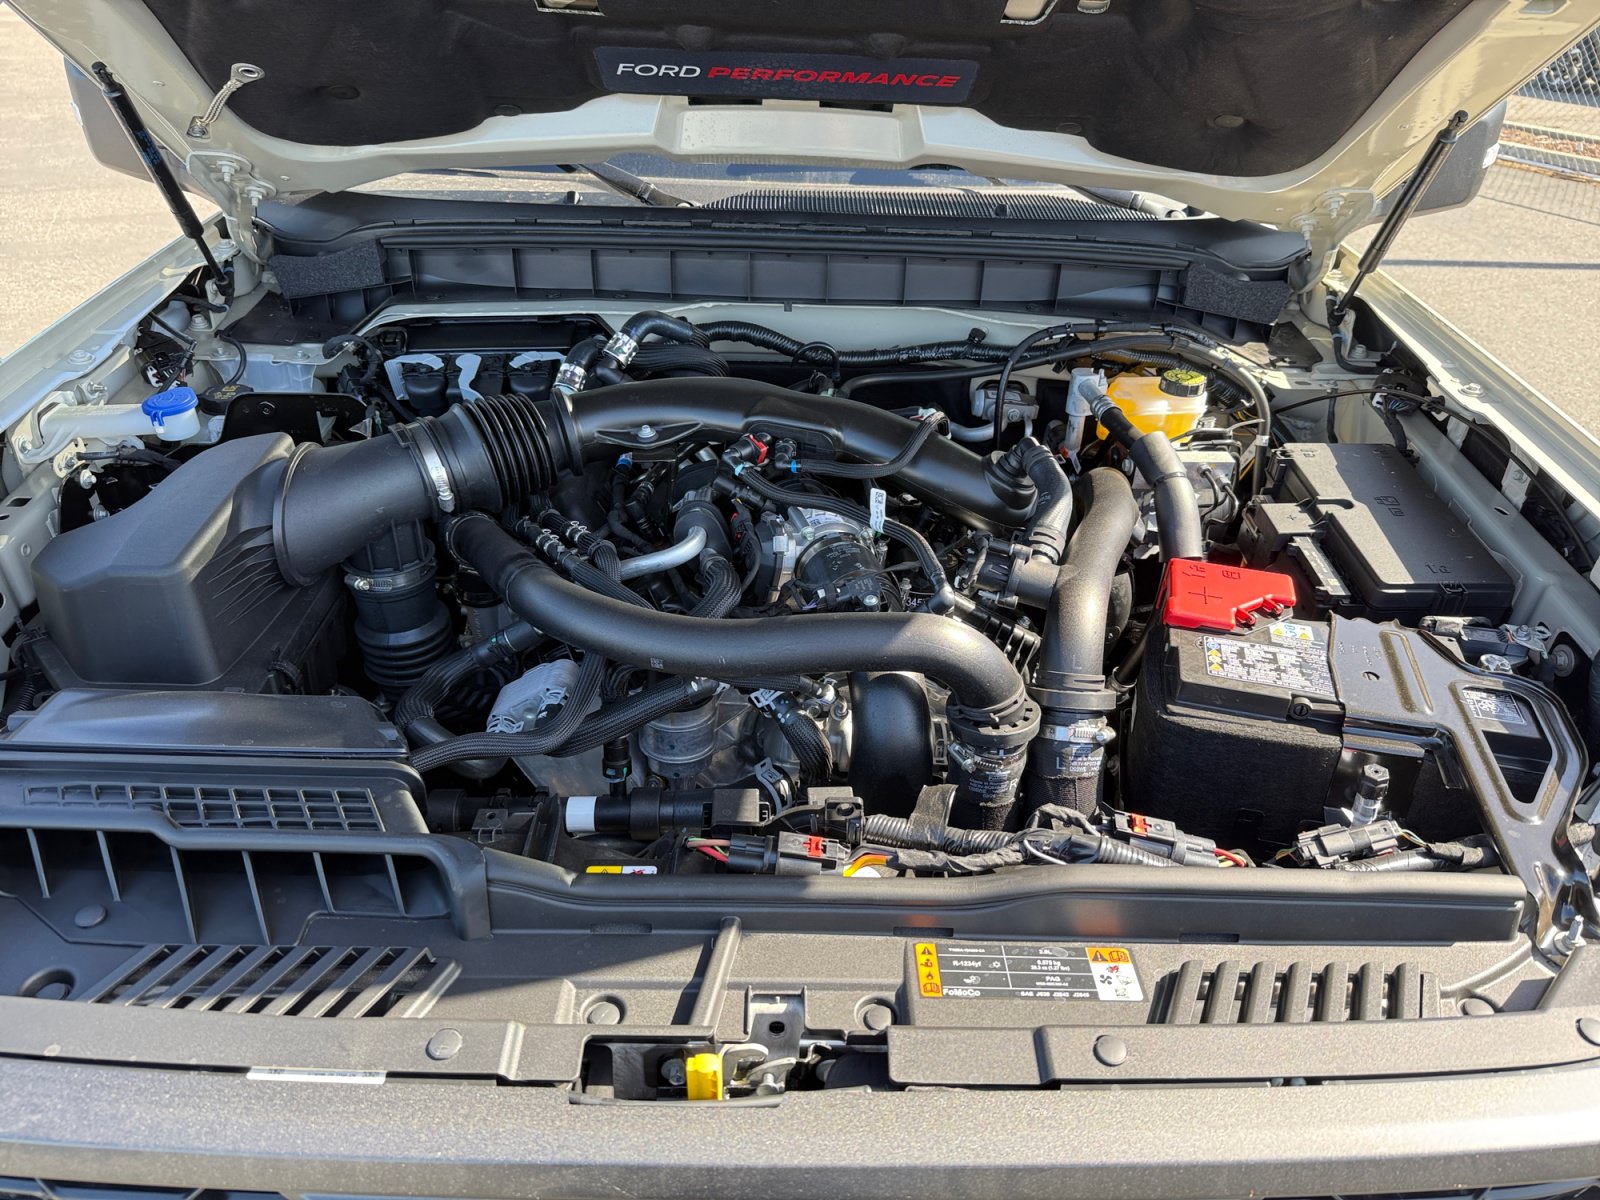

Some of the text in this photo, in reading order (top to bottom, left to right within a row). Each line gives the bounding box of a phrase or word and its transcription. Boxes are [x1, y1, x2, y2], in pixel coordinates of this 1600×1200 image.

[616, 63, 961, 87] FORD PERFORMANCE
[952, 960, 982, 968] R-1234yf
[942, 988, 981, 997] FoMoCo
